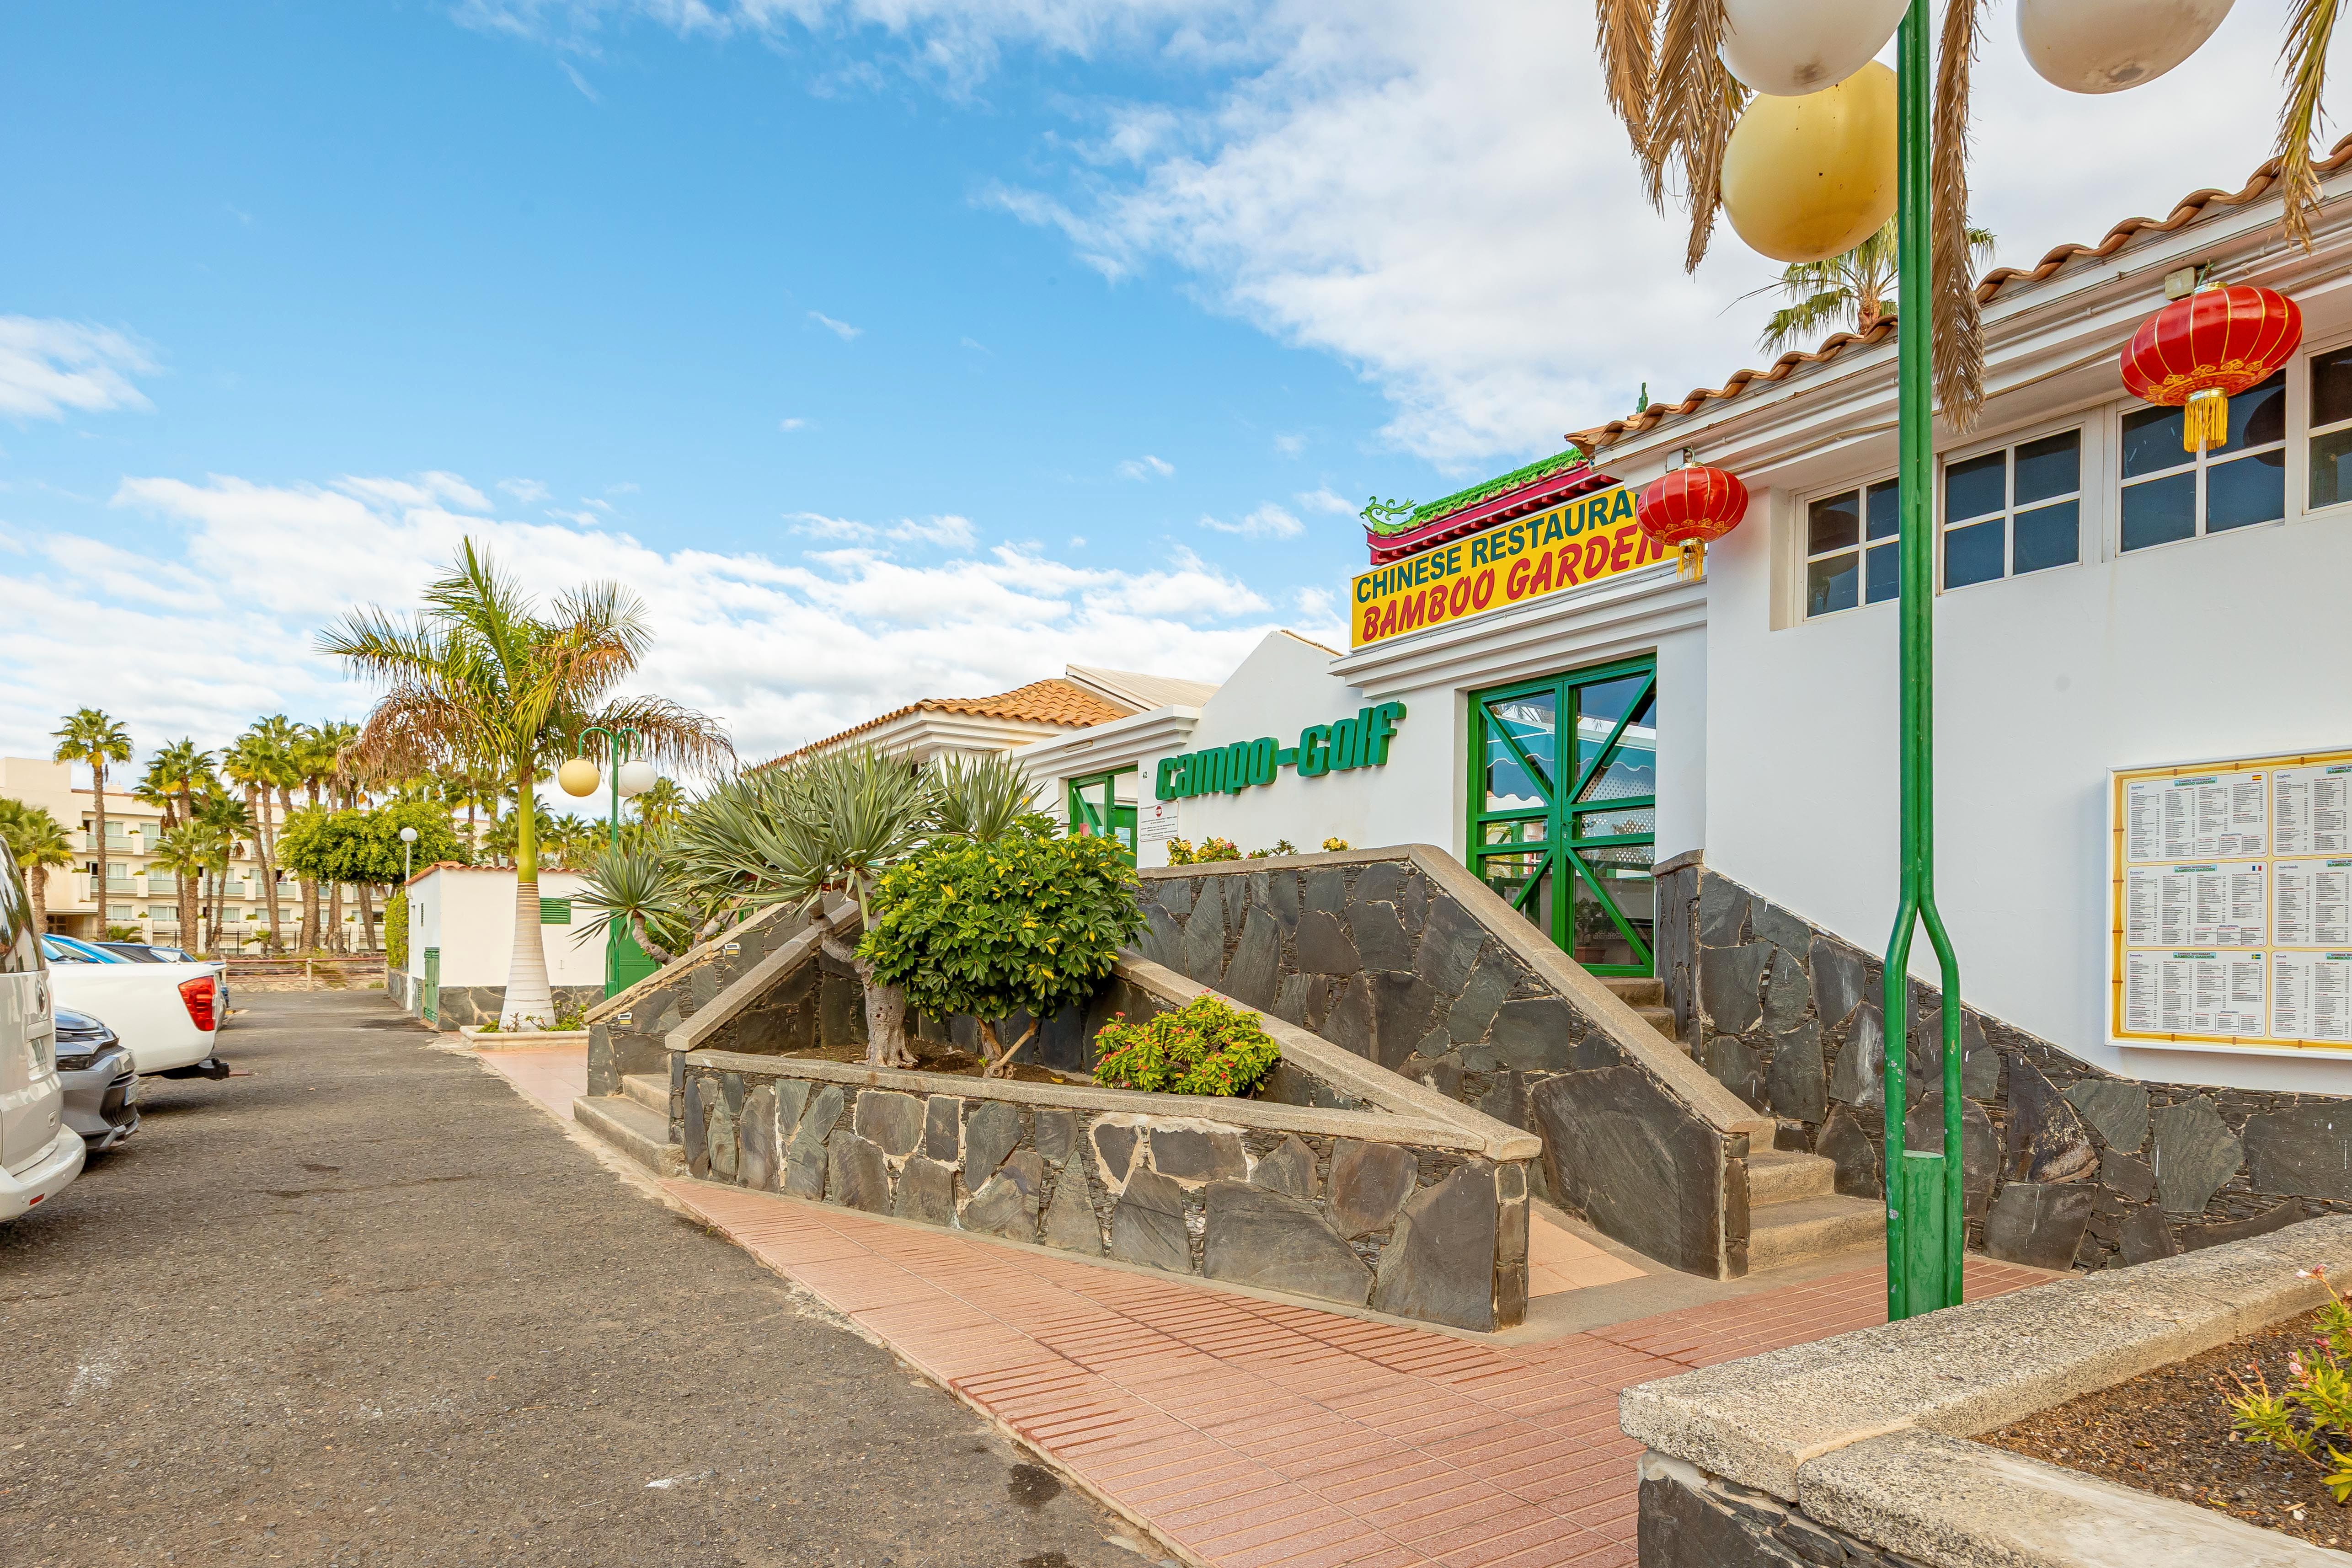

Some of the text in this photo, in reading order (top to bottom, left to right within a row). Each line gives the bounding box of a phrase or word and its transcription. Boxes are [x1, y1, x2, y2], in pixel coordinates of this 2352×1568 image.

[1357, 490, 1640, 603] CHINESE RESTAURA
[1363, 524, 1666, 642] BAMBOO GARDEN
